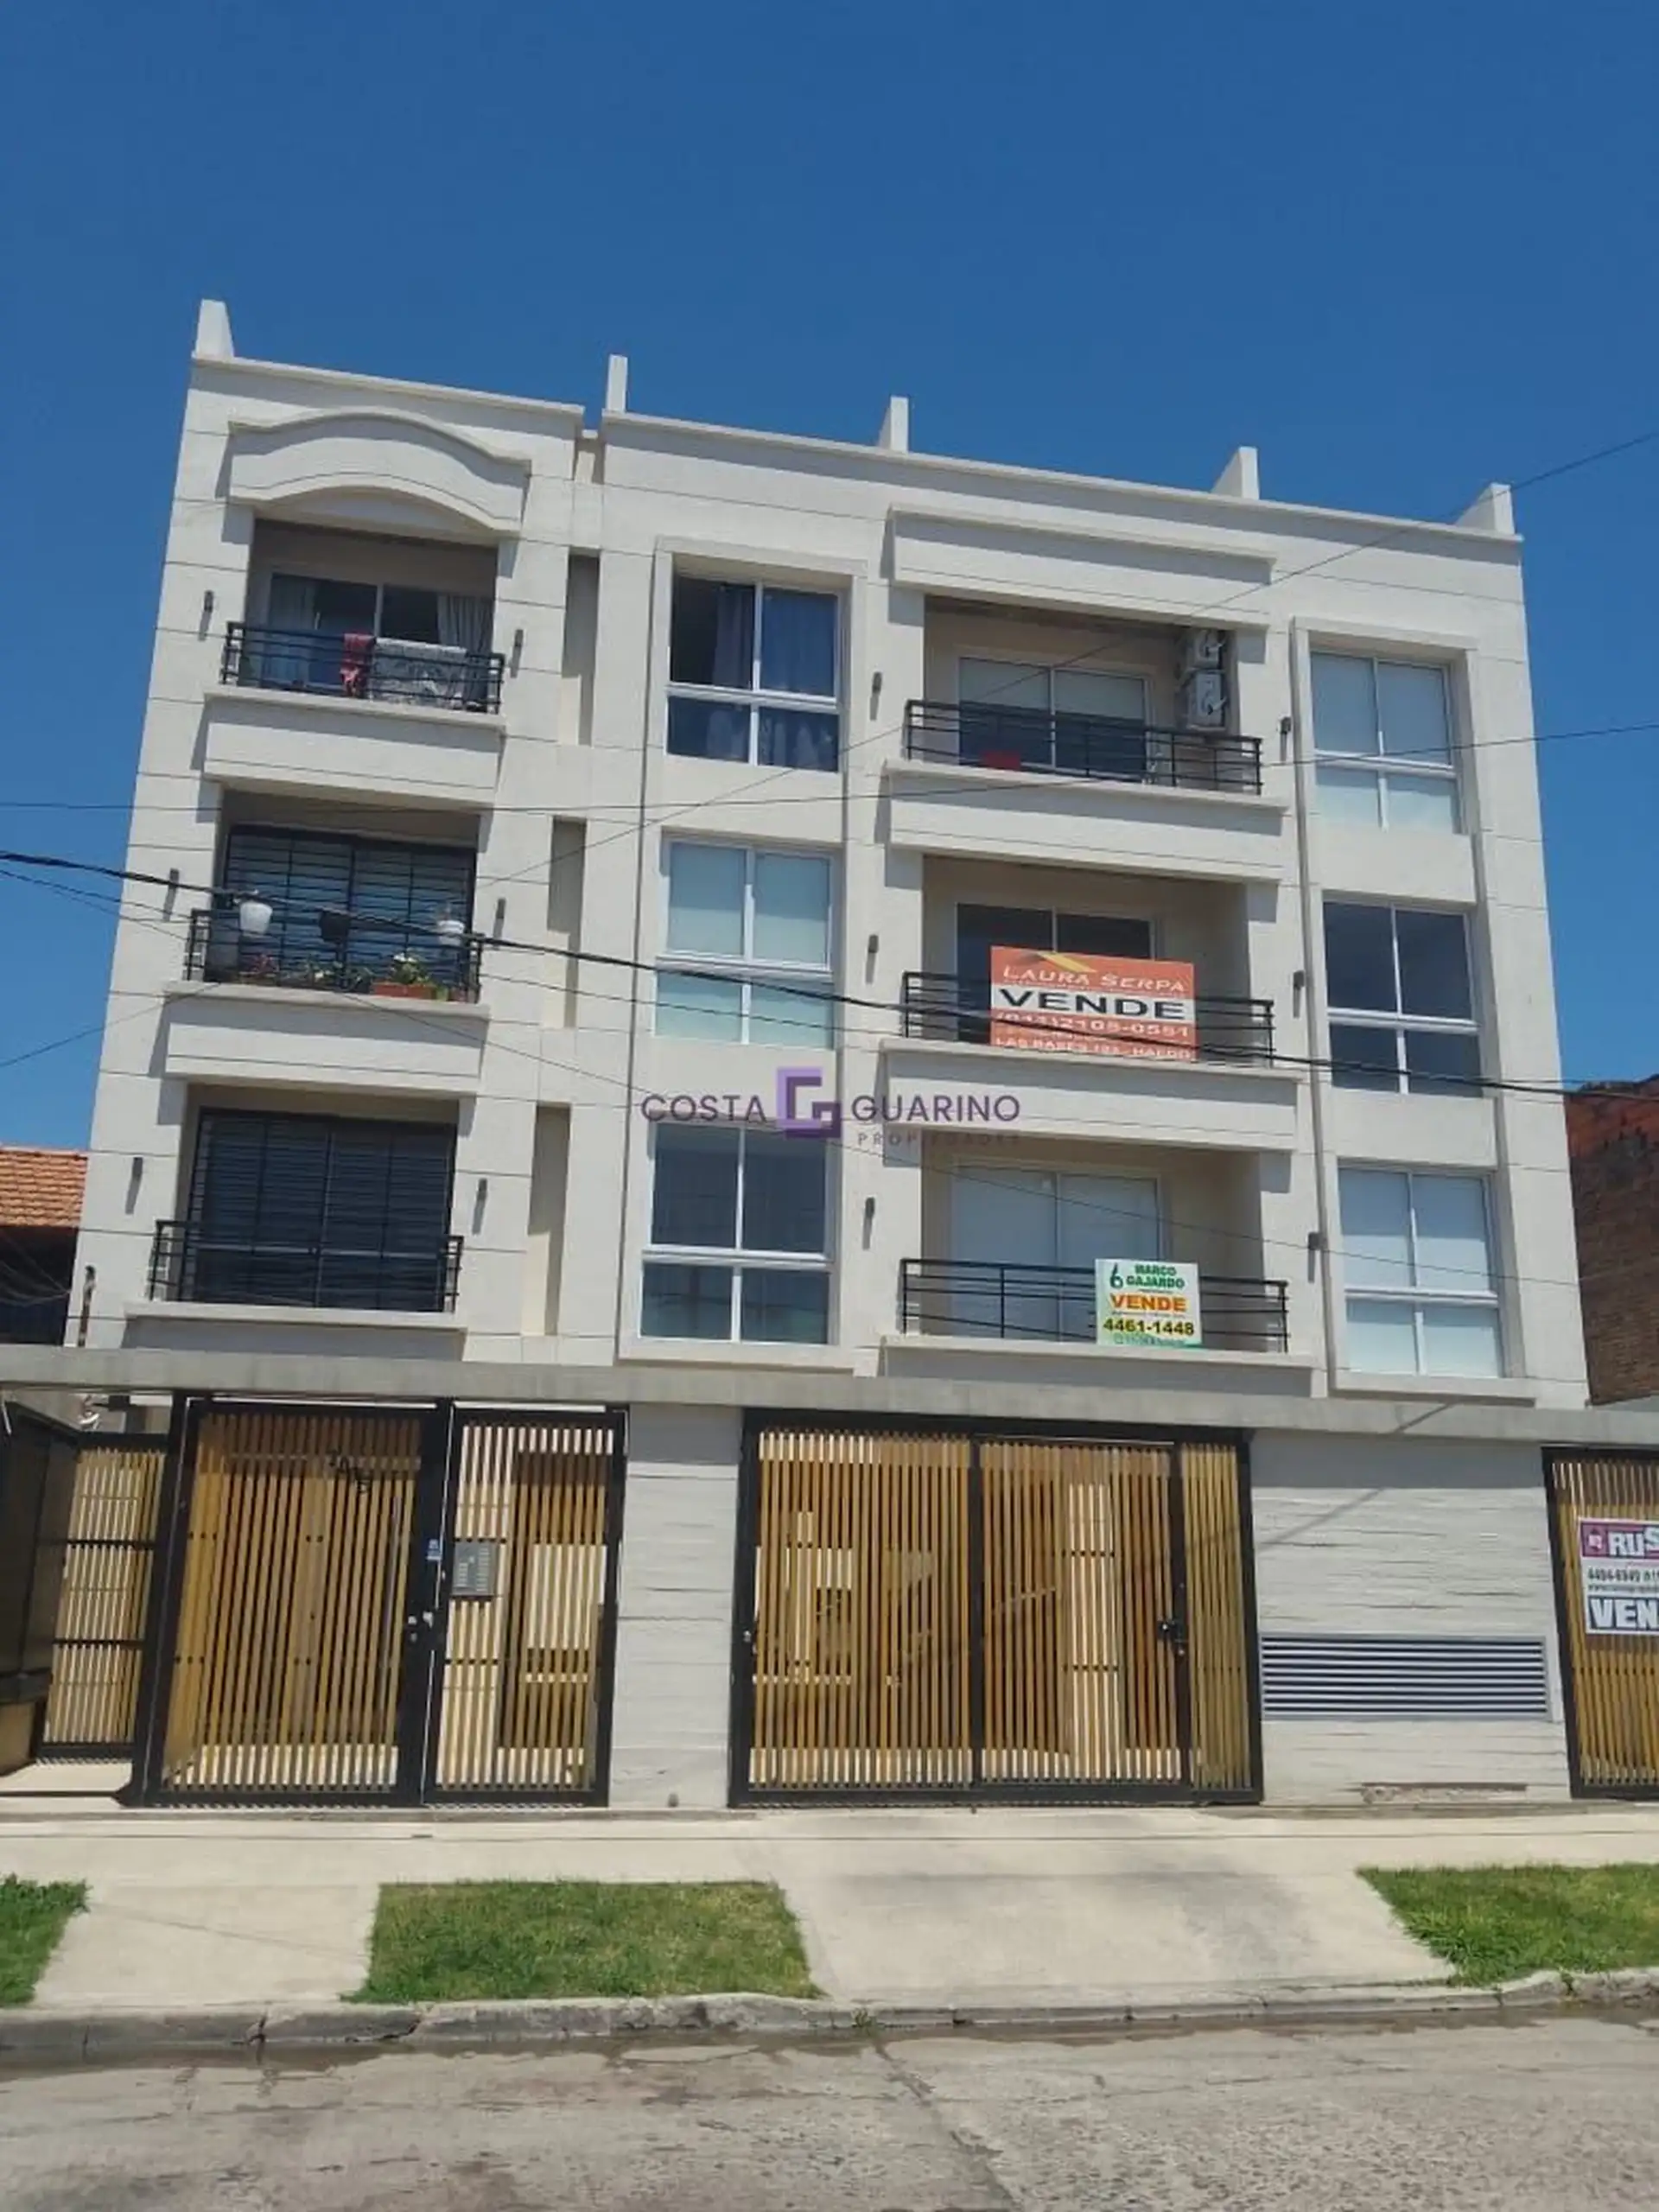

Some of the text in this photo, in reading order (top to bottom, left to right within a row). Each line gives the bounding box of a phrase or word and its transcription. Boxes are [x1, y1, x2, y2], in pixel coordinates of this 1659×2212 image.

[1002, 964, 1090, 986] LAURA
[1102, 973, 1185, 992] SERPA
[1000, 988, 1185, 1020] VENDE
[1110, 1294, 1186, 1311] VENDE
[1103, 1318, 1194, 1336] 4461-1448
